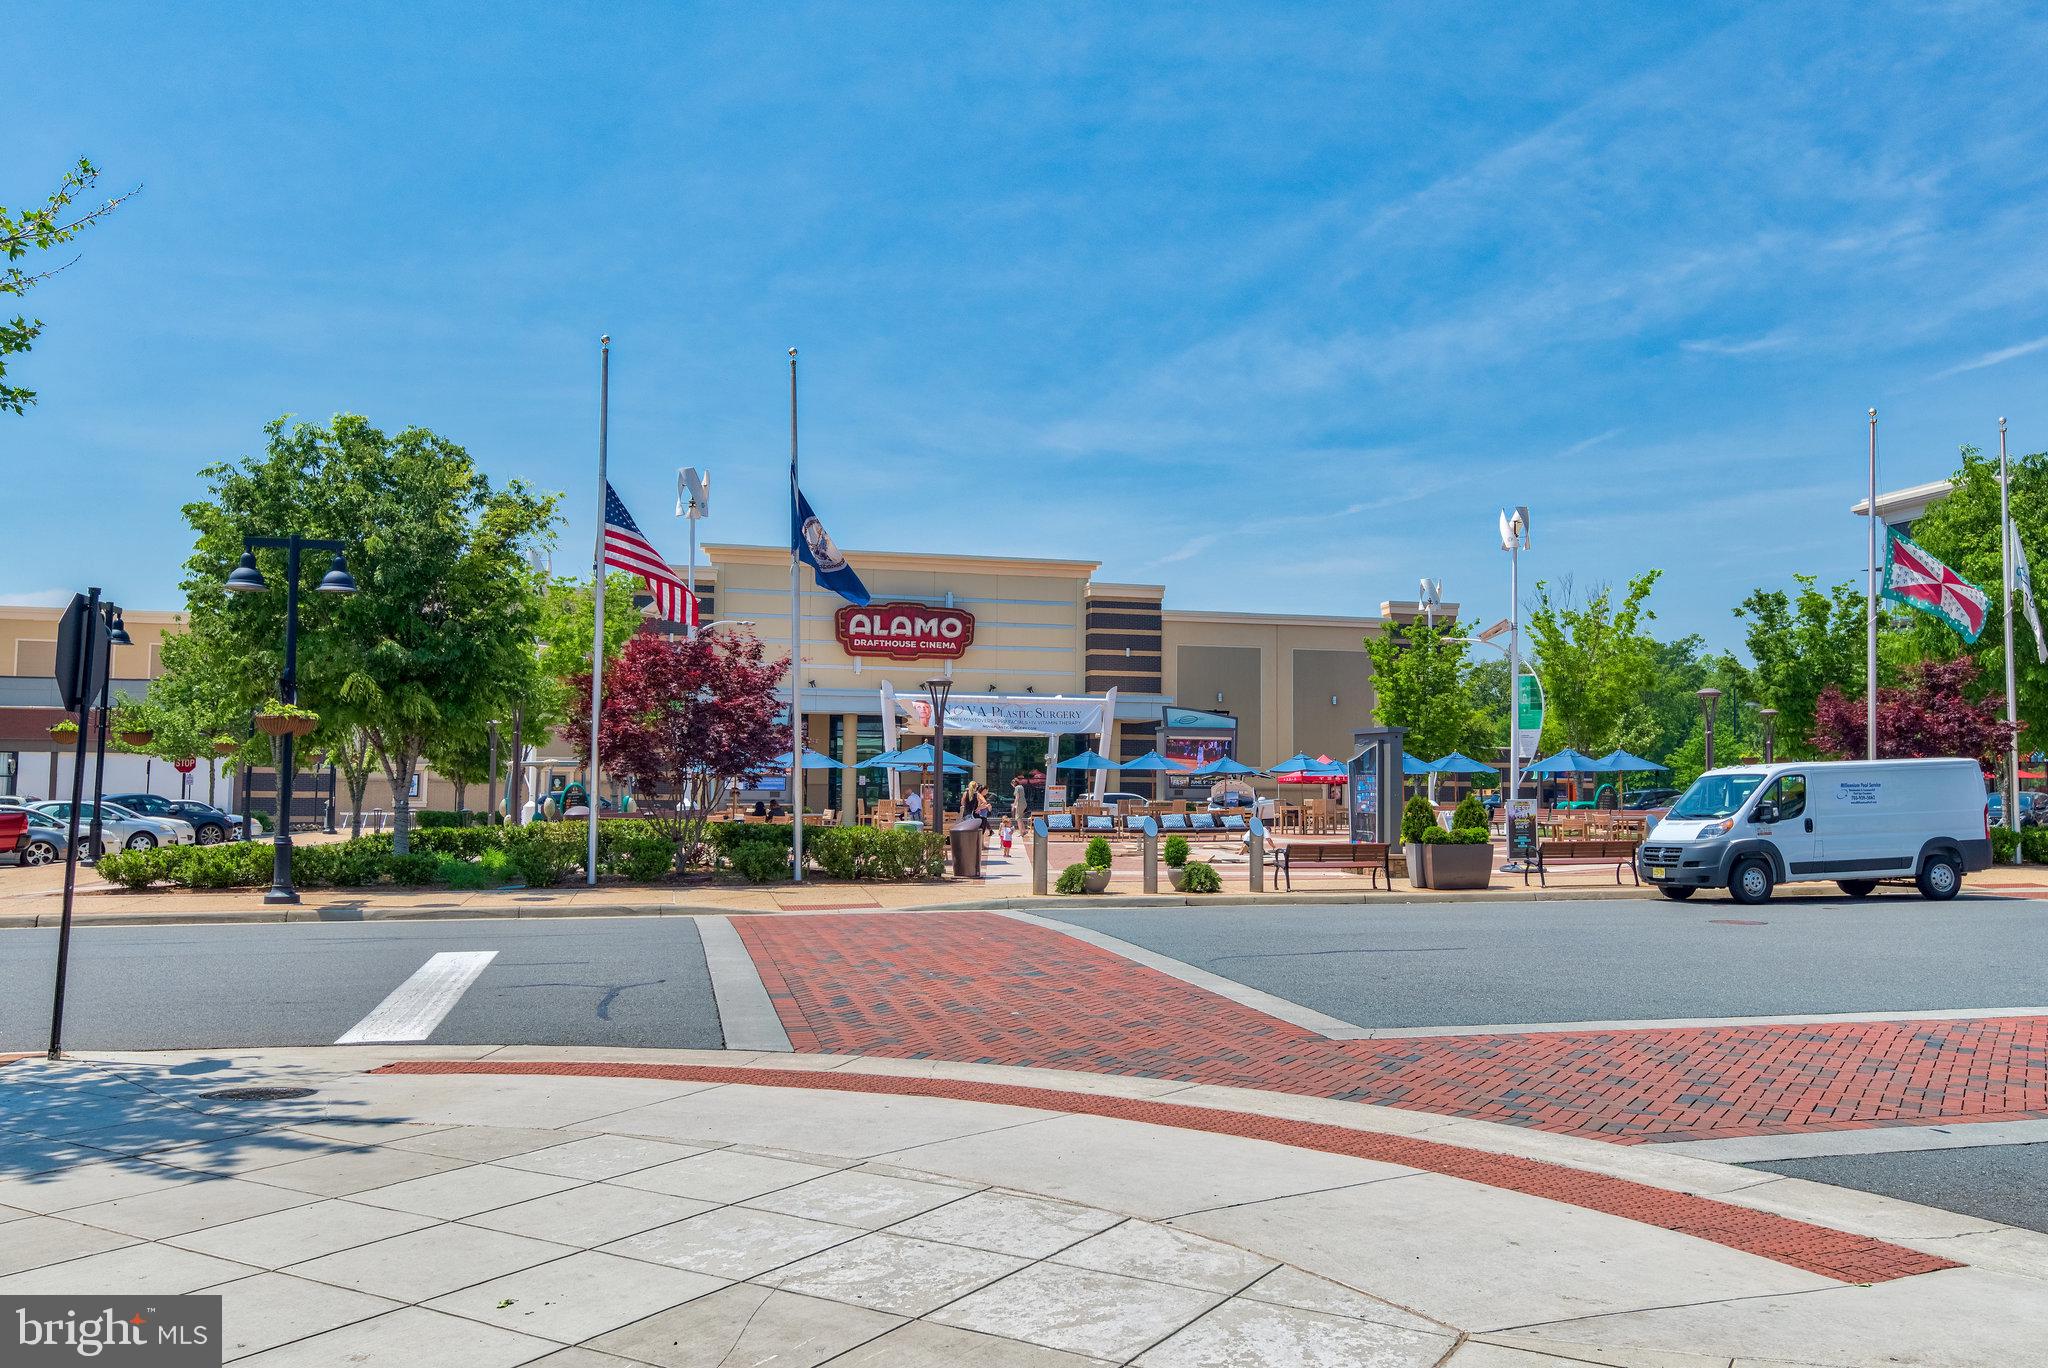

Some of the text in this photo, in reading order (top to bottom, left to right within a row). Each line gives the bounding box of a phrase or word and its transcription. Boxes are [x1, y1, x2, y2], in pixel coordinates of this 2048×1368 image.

[849, 614, 963, 638] ALAMO
[854, 638, 957, 649] DRAFTHOUSE CINEMA
[1035, 708, 1082, 719] SURGERY
[175, 759, 195, 767] STOP
